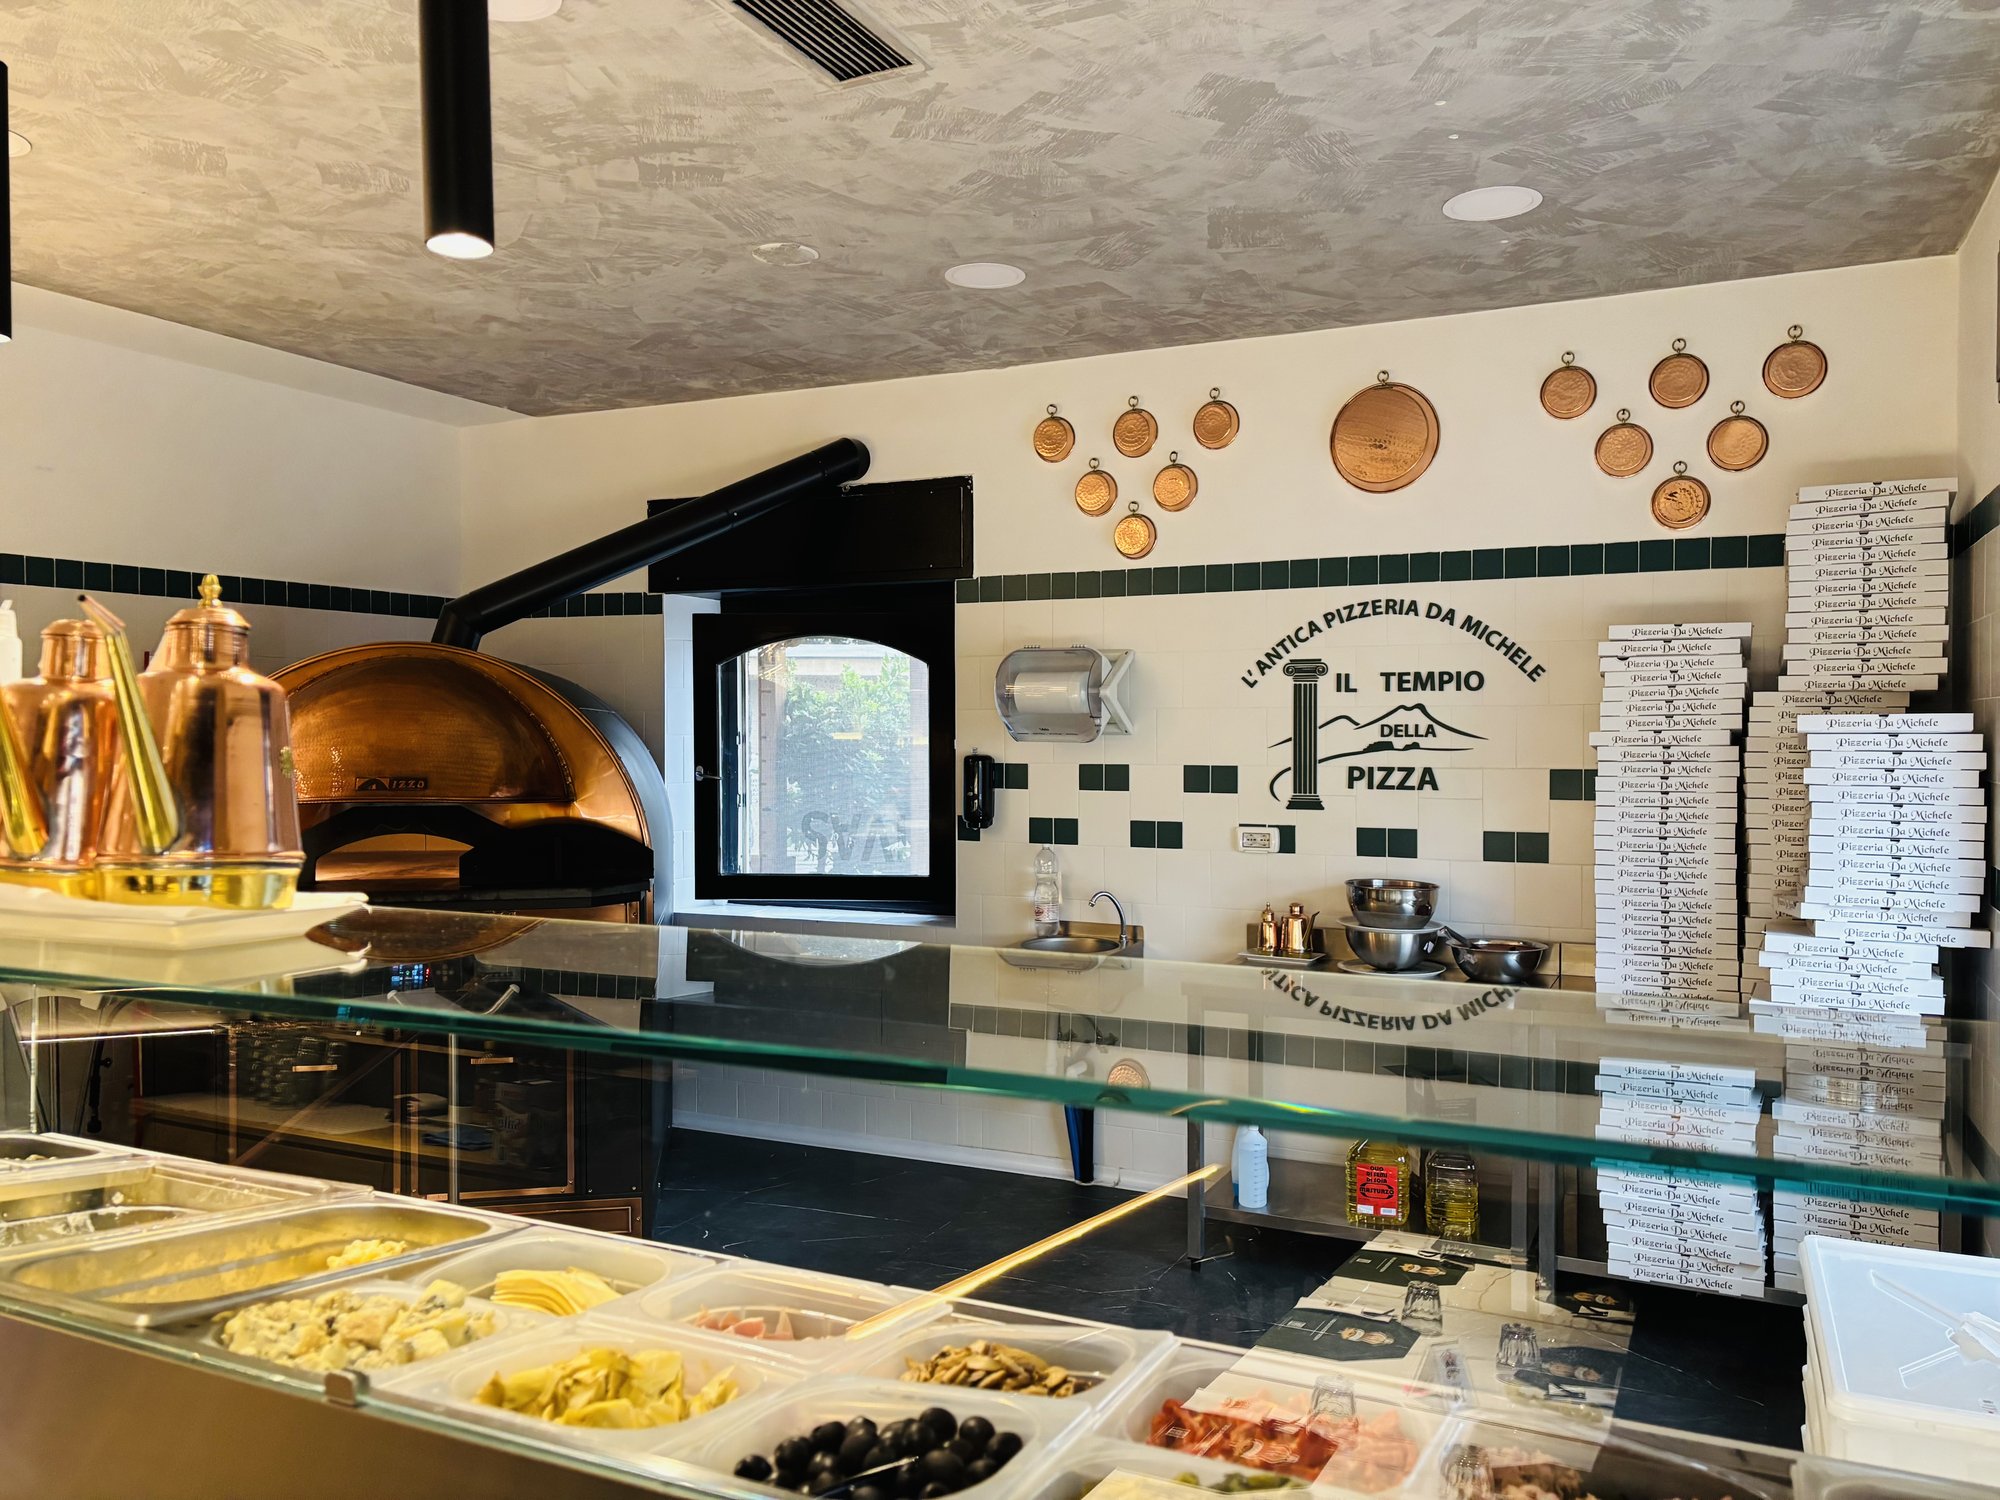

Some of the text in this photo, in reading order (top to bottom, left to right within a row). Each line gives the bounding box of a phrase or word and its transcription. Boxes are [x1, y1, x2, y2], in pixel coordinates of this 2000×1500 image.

[1816, 498, 1917, 516] Pizzeria Da Michele
[1815, 549, 1916, 564] Pizzeria Da Michele
[1816, 565, 1917, 579] Pizzeria Da Michele
[1815, 581, 1916, 595] Pizzeria Da Michele
[1815, 597, 1916, 610] Pizzeria Da Michele
[1632, 627, 1722, 638] Pizzeria Da Michele
[1815, 629, 1917, 642] Pizzeria Da Michele
[1241, 598, 1547, 688] L'ANTICA PIZZERIA DA MICHELE
[1621, 643, 1711, 654] Pizzeria Da Michele
[1810, 646, 1911, 658] Pizzeria Da Michele
[1813, 662, 1915, 674] Pizzeria Da Michele
[1336, 670, 1485, 693] IL TEMPIO
[1782, 695, 1882, 705] Pizzeria Da Michele
[1626, 718, 1716, 729] Pizzeria Da Michele
[1826, 718, 1938, 731] Pizzeria Da Michele
[1380, 724, 1437, 738] DELLA
[1612, 735, 1701, 745] Pizzeria Da Michele
[1836, 738, 1948, 749] Pizzeria Da Michele
[1840, 756, 1952, 767] Pizzeria Da Michele
[1621, 765, 1711, 775] Pizzeria Da Michele
[1347, 766, 1439, 791] PIZZA
[1832, 772, 1944, 784] Pizzeria Da Michele
[1619, 781, 1708, 790] Pizzeria Da Michele
[1619, 796, 1709, 805] Pizzeria Da Michele
[1838, 791, 1950, 802] Pizzeria Da Michele
[1839, 825, 1950, 837] Pizzeria Da Michele
[1838, 842, 1949, 855] Pizzeria Da Michele
[1619, 855, 1708, 865] Pizzeria Da Michele
[1839, 859, 1951, 873] Pizzeria Da Michele
[1618, 869, 1707, 880] Pizzeria Da Michele
[1838, 876, 1949, 890] Pizzeria Da Michele
[1622, 899, 1712, 910] Pizzeria Da Michele
[1622, 913, 1712, 925] Pizzeria Da Michele
[1830, 909, 1938, 923] Pizzeria Da Michele
[1622, 927, 1712, 939] Pizzeria Da Michele
[1622, 943, 1712, 955] Pizzeria Da Michele
[1622, 958, 1713, 971] Pizzeria Da Michele
[1621, 974, 1712, 986] Pizzeria Da Michele
[1625, 1066, 1723, 1081] Pizzeria Da Michele
[1620, 1083, 1718, 1099] Pizzeria Da Michele
[1628, 1100, 1726, 1117] Pizzeria Da Michele
[1622, 1183, 1720, 1205] Pizzeria Da Michele
[1625, 1202, 1724, 1223] Pizzeria Da Michele
[1804, 1197, 1909, 1219] Pizzeria Da Michele
[1804, 1213, 1909, 1236] Pizzeria Da Michele
[1634, 1253, 1734, 1273] Pizzeria Da Michele
[1633, 1267, 1732, 1290] Pizzeria Da Michele
